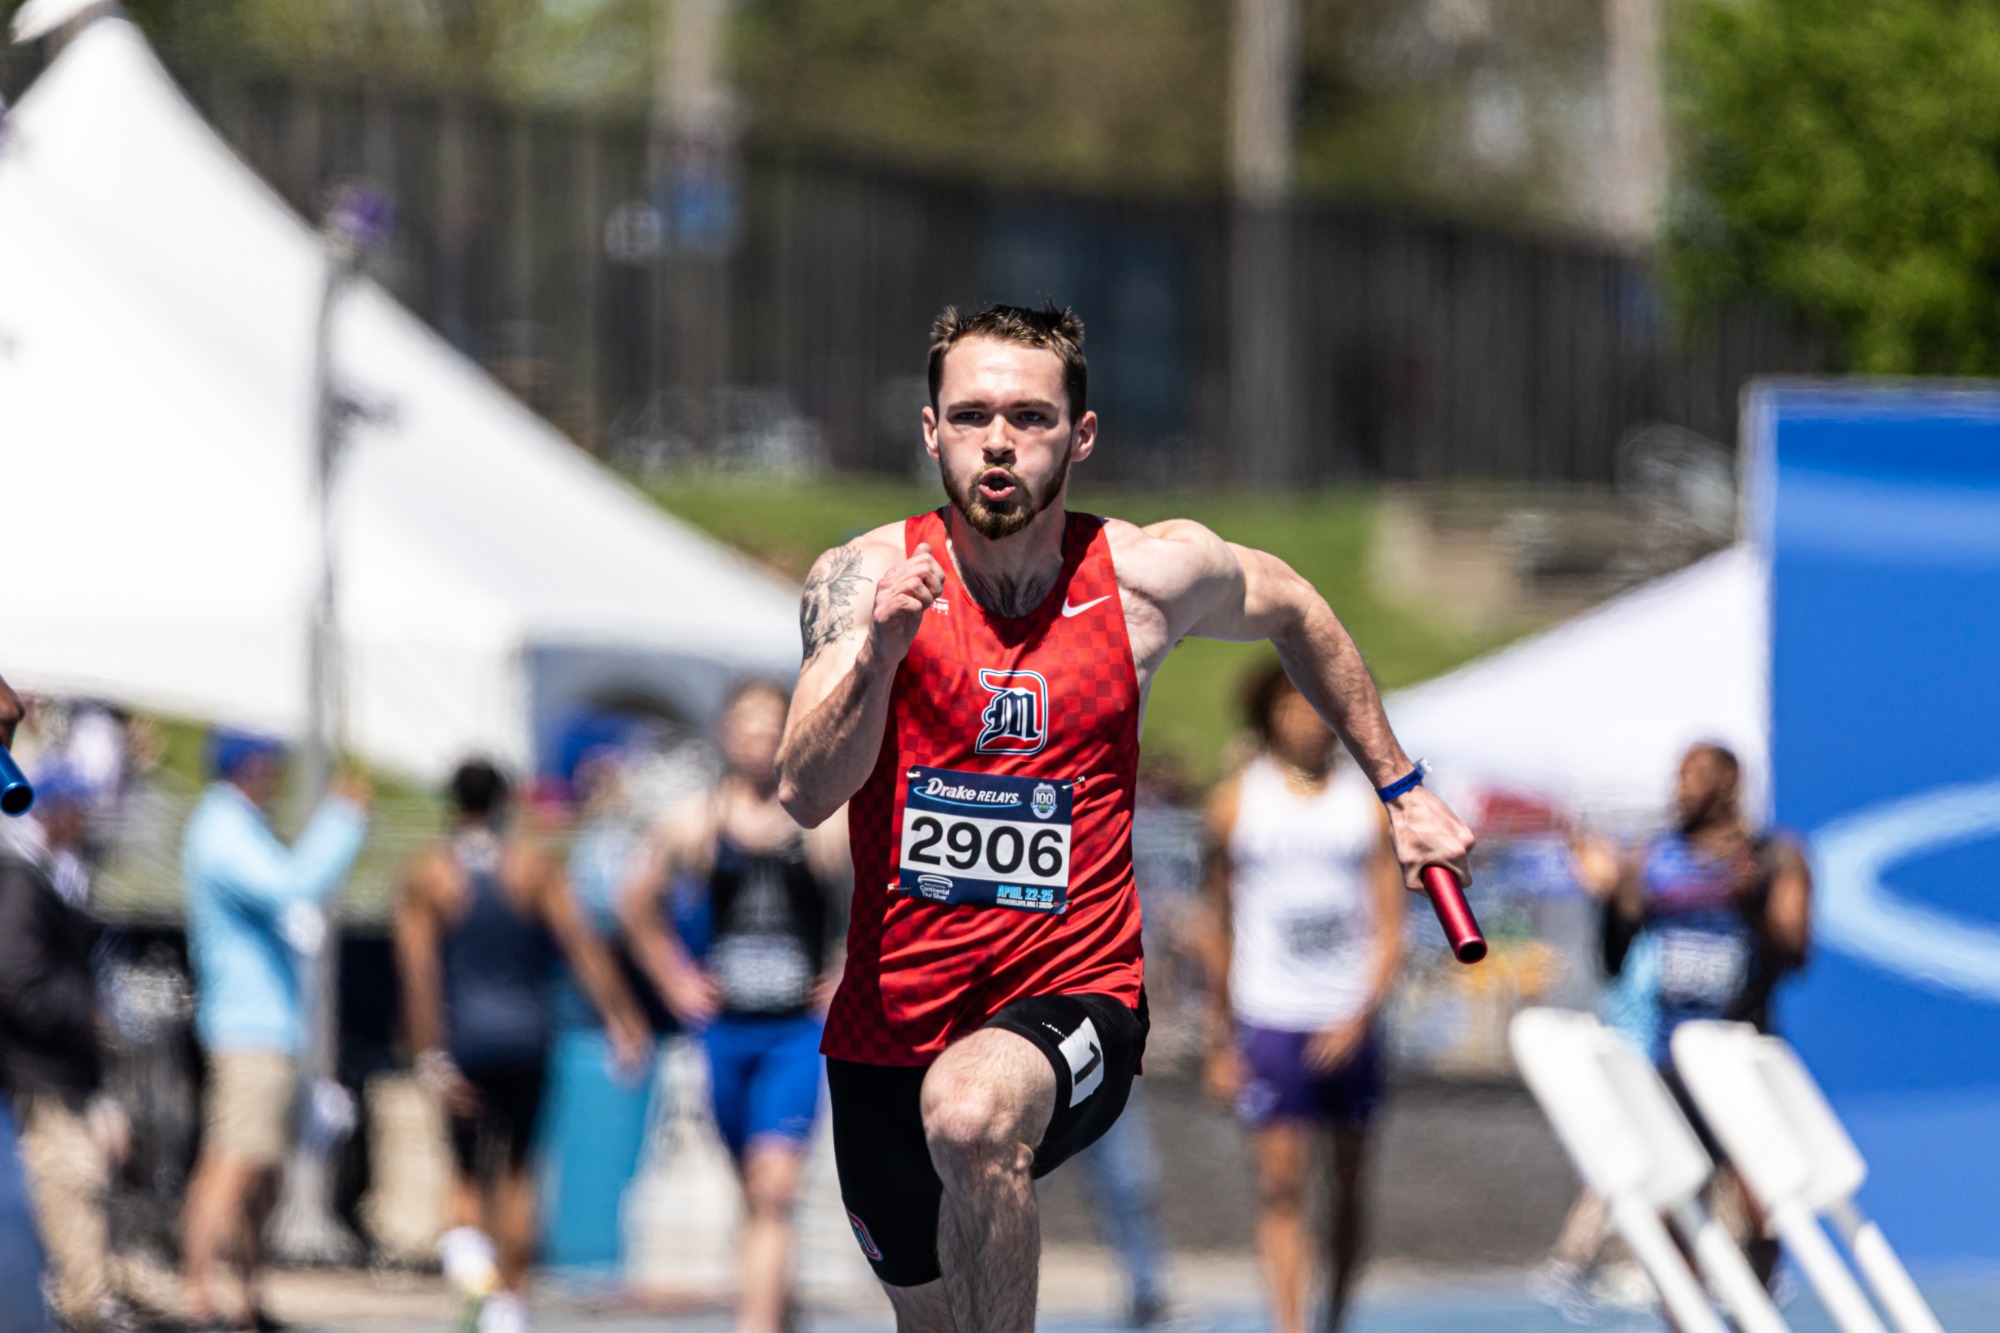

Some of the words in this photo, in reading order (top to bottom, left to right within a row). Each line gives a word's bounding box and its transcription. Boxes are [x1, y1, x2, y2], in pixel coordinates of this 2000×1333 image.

[925, 777, 977, 800] Drake
[976, 790, 1019, 804] RELAYS
[1036, 793, 1053, 804] 100
[908, 816, 1063, 878] 2906
[997, 884, 1023, 899] APRIL
[1025, 887, 1053, 902] 22-25
